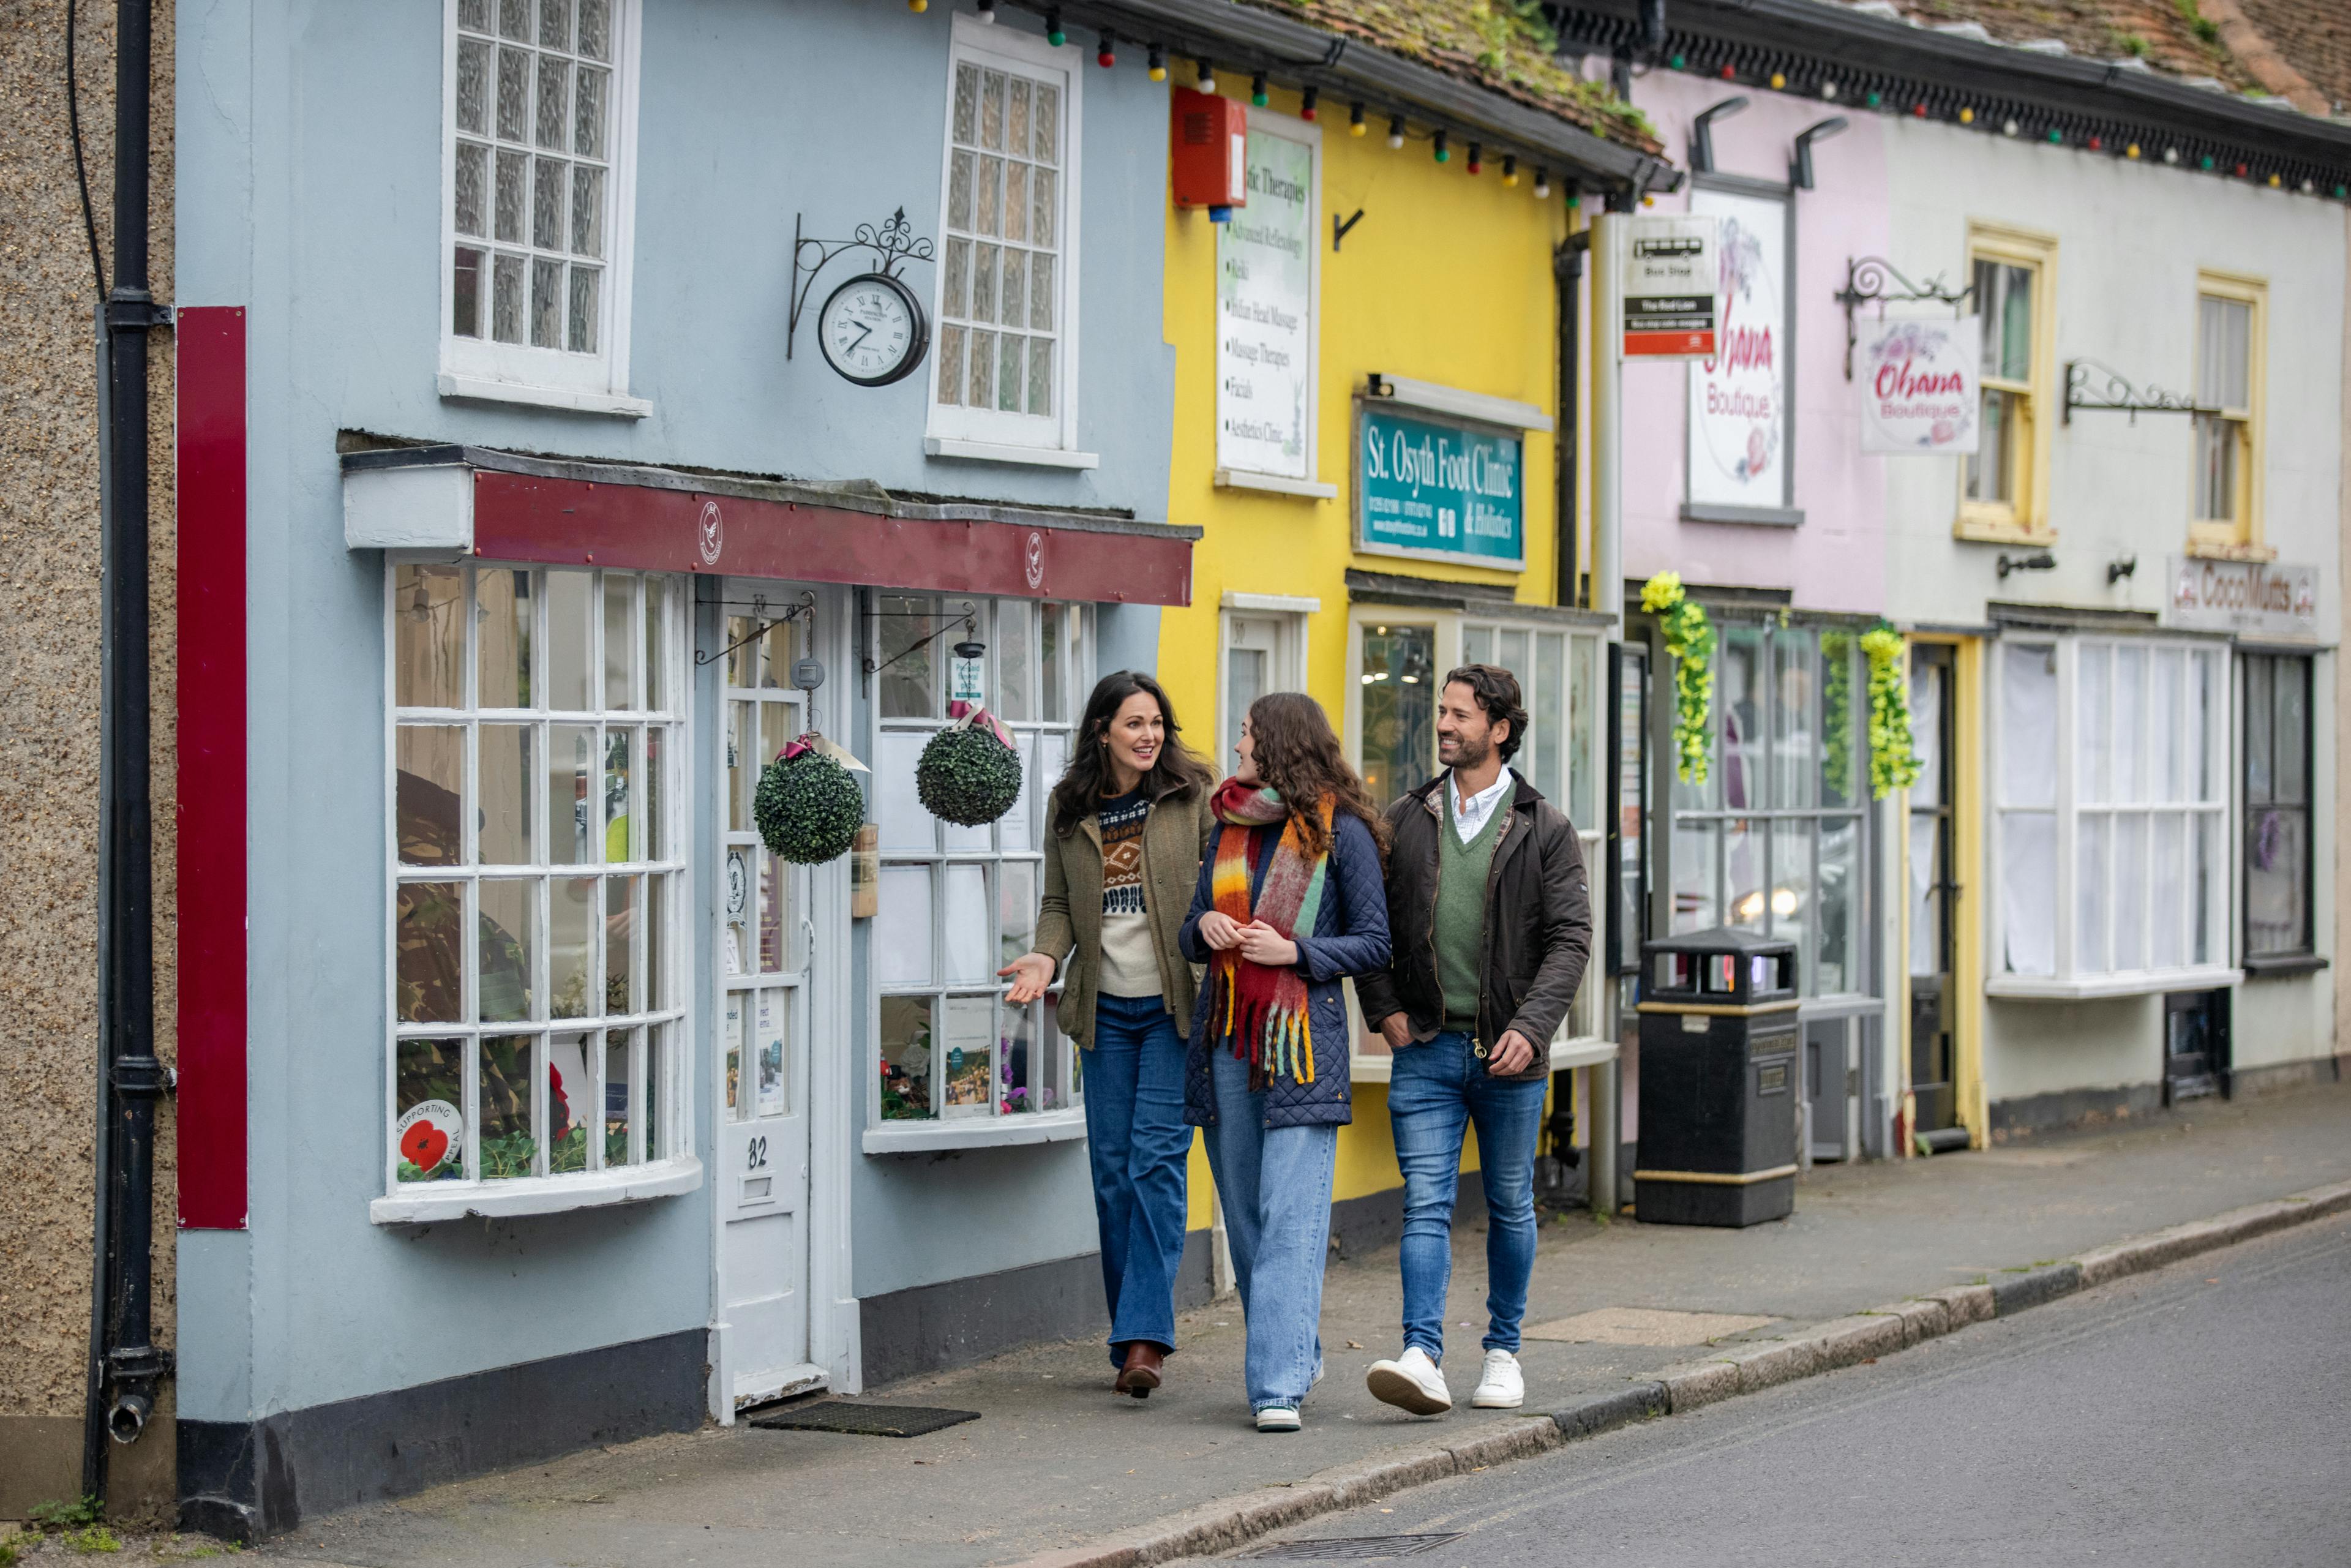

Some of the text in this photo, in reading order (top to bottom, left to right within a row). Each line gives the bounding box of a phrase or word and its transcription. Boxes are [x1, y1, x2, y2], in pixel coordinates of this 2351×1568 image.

[1262, 167, 1305, 208] Therapies
[1231, 258, 1250, 280] Reiki
[1668, 267, 1692, 277] Stop
[1231, 297, 1297, 335] Indian Head Massage
[1641, 299, 1658, 312] The
[1658, 299, 1676, 312] Red
[1704, 291, 1774, 377] hana
[1231, 337, 1290, 370] Massage Therapies
[1231, 377, 1253, 400] Facials
[1875, 358, 1964, 402] Ohana
[1706, 383, 1771, 421] Boutique
[1880, 403, 1960, 422] Boutique
[1231, 419, 1283, 445] Aesthetics Clinic
[1368, 425, 1513, 499] St. Osyth Foot Clinic
[1464, 501, 1474, 534] &
[1474, 503, 1512, 539] Holistics
[397, 1105, 451, 1135] SUPPORTING
[446, 1128, 460, 1160] PPEAL
[748, 1135, 768, 1171] 82
